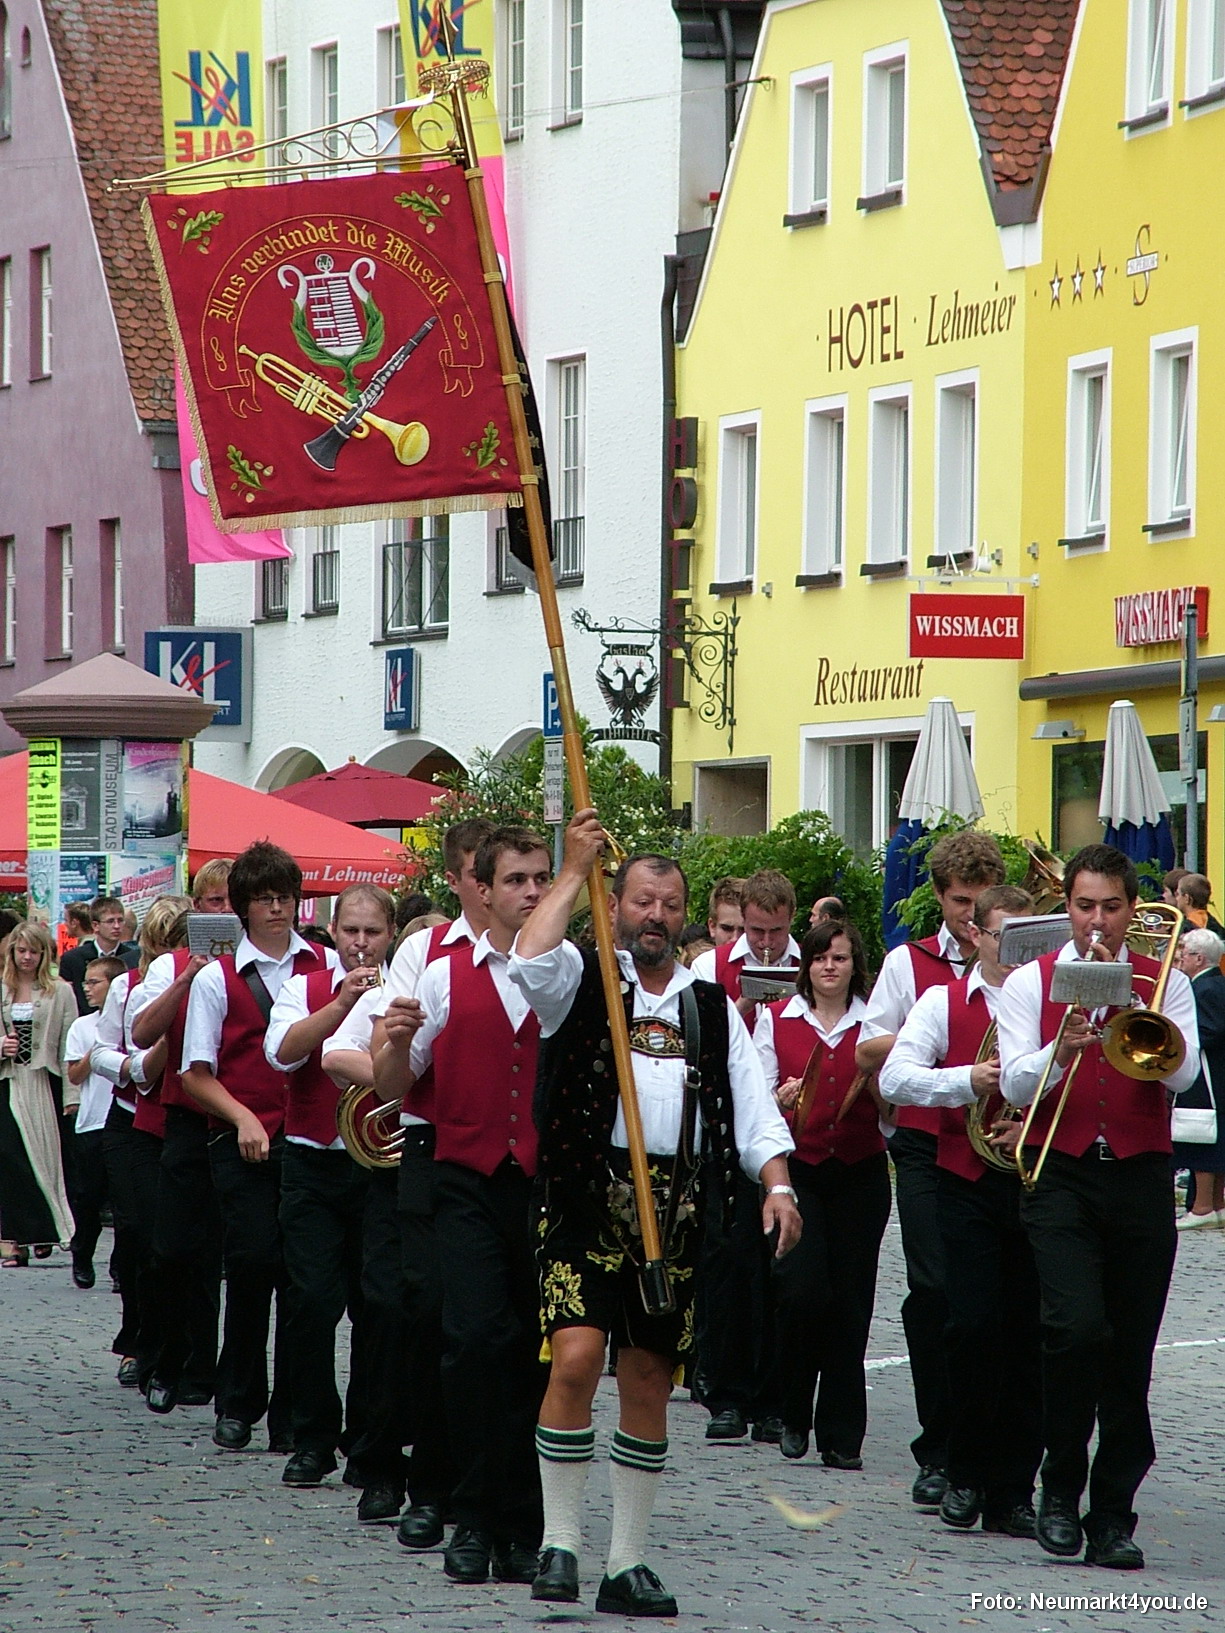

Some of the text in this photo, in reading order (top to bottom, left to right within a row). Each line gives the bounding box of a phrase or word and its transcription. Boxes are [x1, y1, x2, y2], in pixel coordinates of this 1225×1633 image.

[208, 219, 452, 324] Uns verbindet die Musik
[828, 281, 1017, 372] HOTEL Lehmeier
[916, 615, 1019, 638] WISSMACH
[814, 657, 924, 706] Restaurant
[105, 752, 118, 849] STADTMUSEUM
